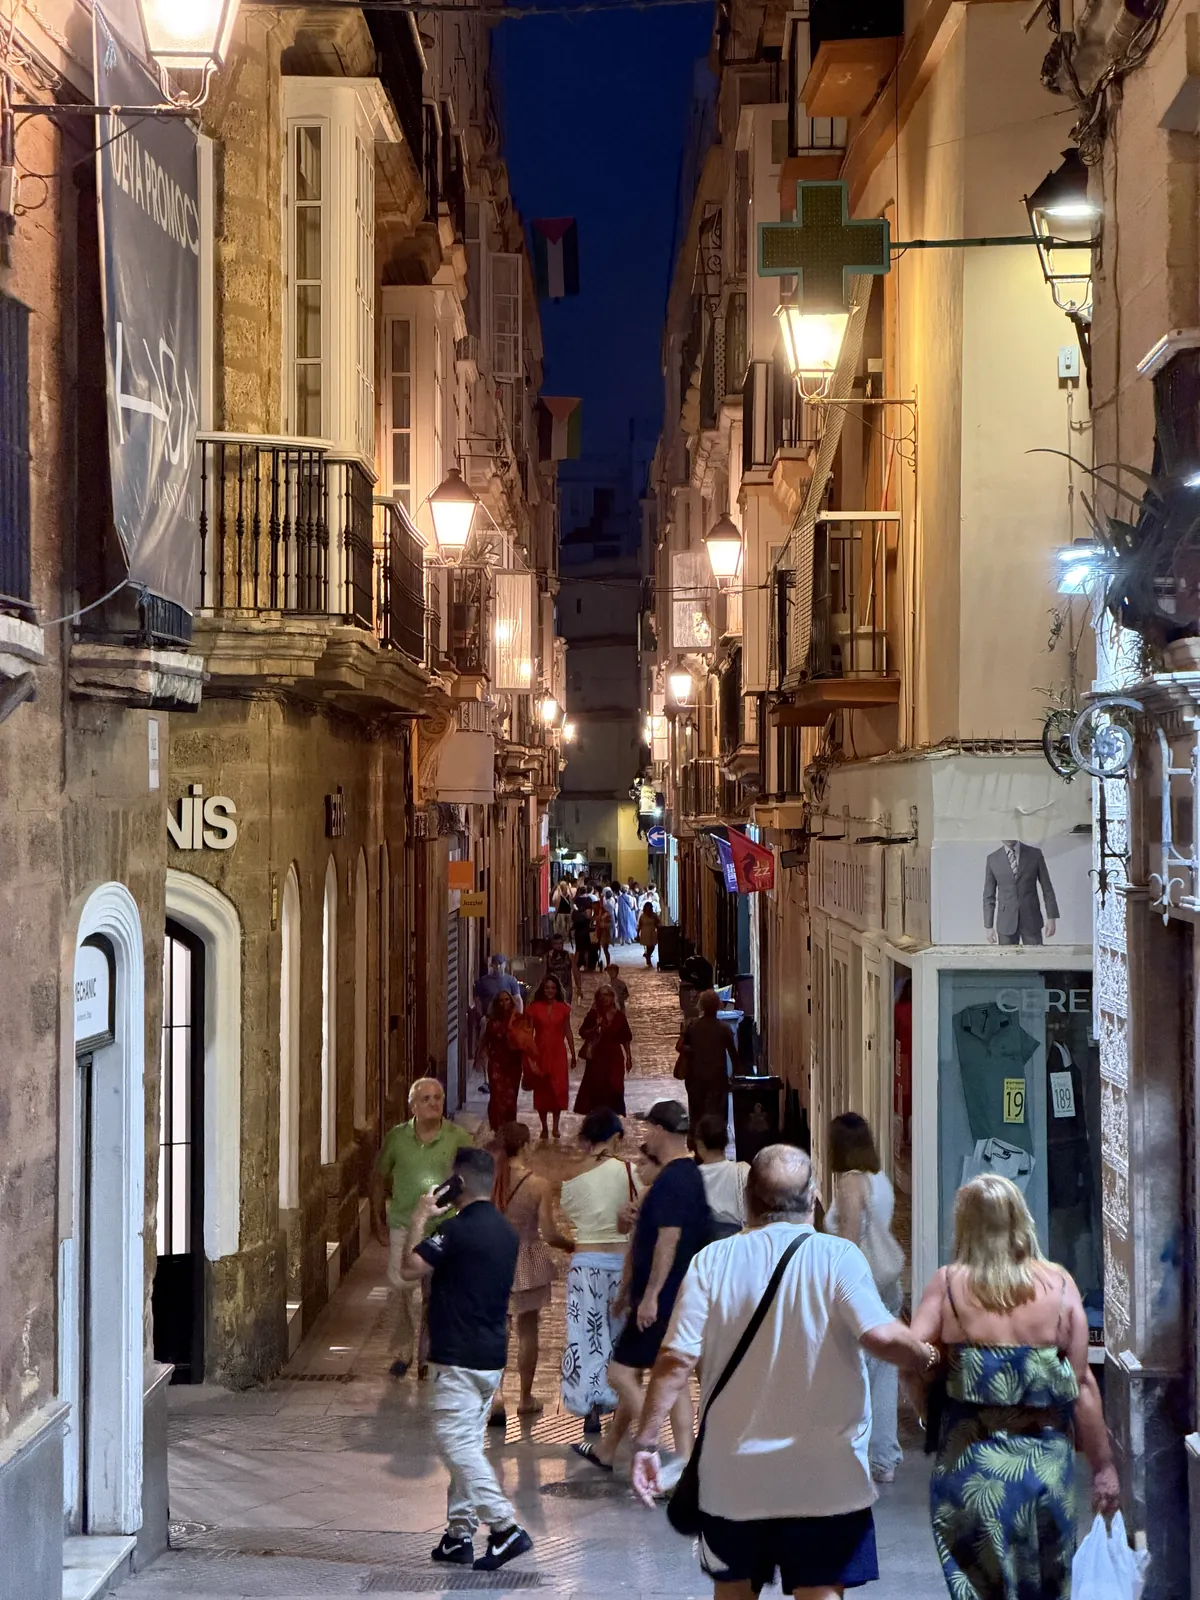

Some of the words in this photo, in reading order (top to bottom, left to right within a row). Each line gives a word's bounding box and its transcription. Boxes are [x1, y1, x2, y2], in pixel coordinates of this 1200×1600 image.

[996, 988, 1090, 1013] CERE
[1006, 1091, 1024, 1118] 19
[1054, 1087, 1072, 1109] 189
